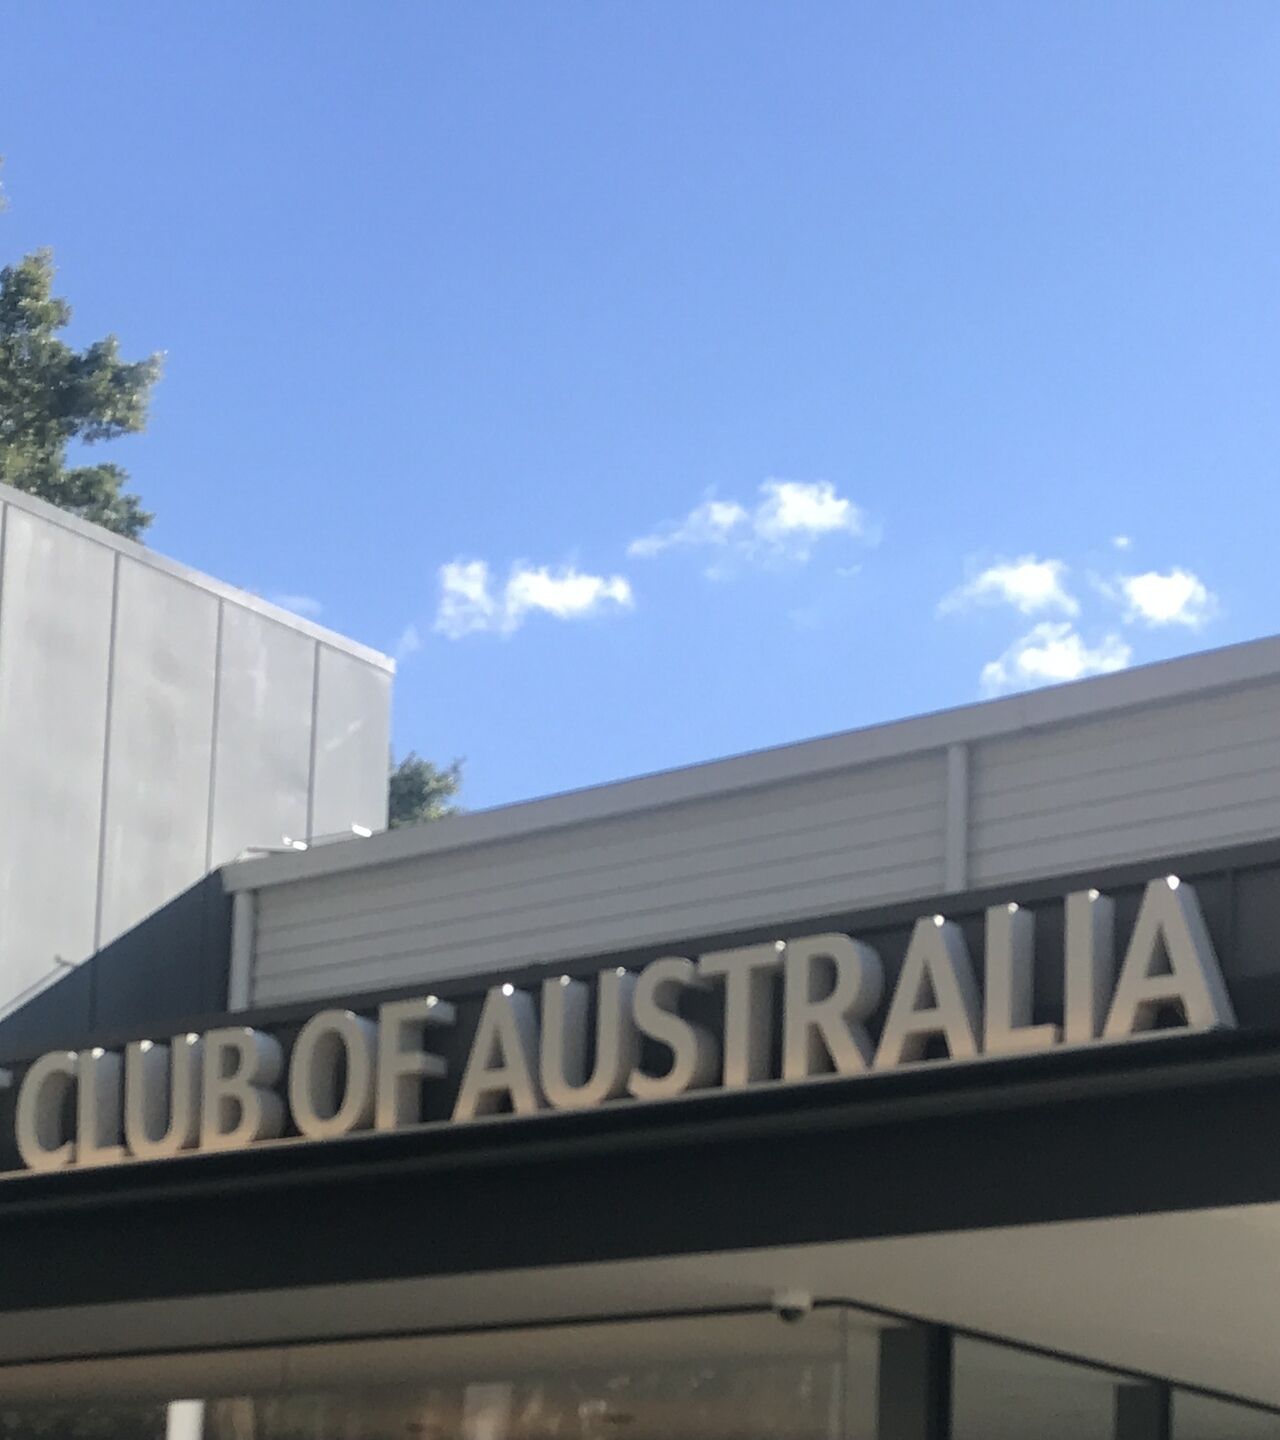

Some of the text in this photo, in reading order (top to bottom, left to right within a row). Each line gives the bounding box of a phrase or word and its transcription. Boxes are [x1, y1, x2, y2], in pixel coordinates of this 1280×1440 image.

[15, 1026, 283, 1172] CLUB
[288, 996, 455, 1141] OF
[452, 875, 1236, 1123] AUSTRALIA
